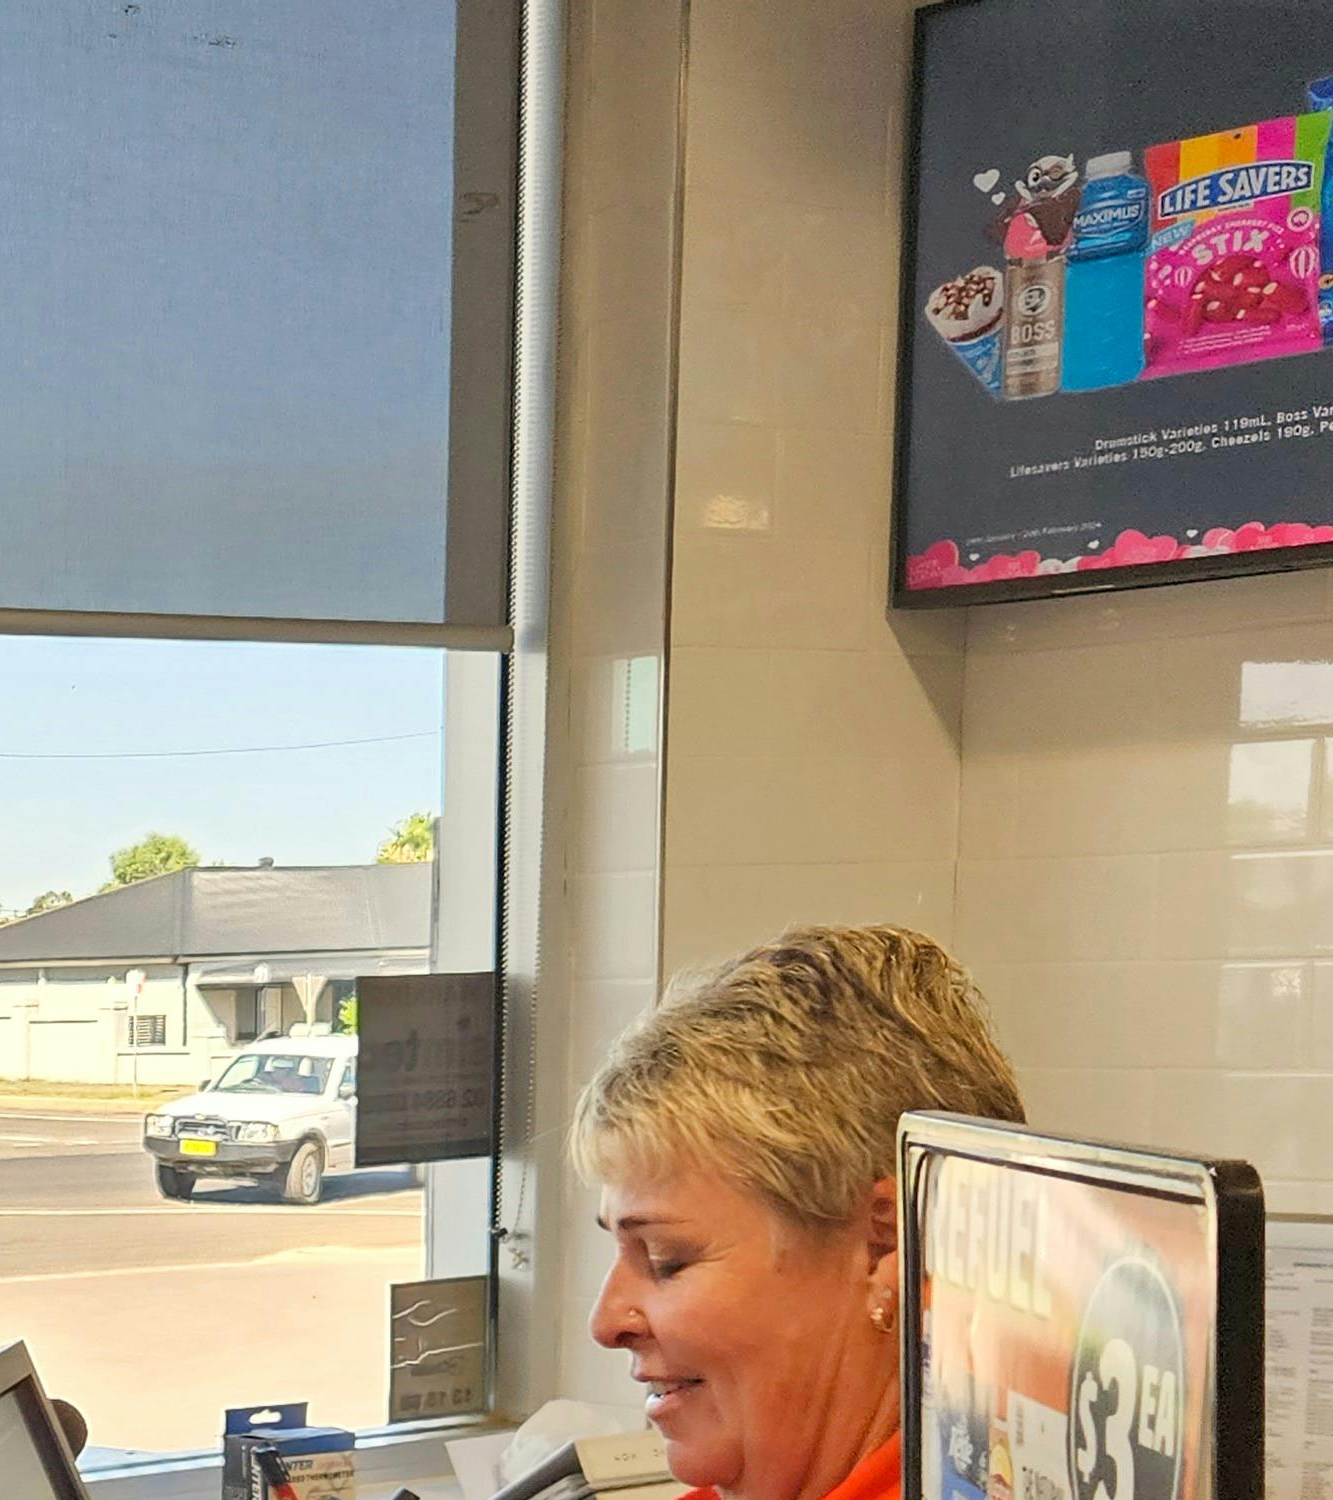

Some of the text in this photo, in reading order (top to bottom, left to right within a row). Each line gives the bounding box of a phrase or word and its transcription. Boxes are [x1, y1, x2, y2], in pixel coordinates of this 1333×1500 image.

[1163, 166, 1311, 213] LIFE SAVERS
[1073, 205, 1139, 227] MAXIMUS
[1192, 229, 1270, 265] STIX
[1010, 320, 1055, 344] BOSS
[1161, 423, 1218, 440] Varieties
[1276, 410, 1308, 424] Boss
[1074, 450, 1127, 468] Varieties
[1139, 1366, 1176, 1459] EA
